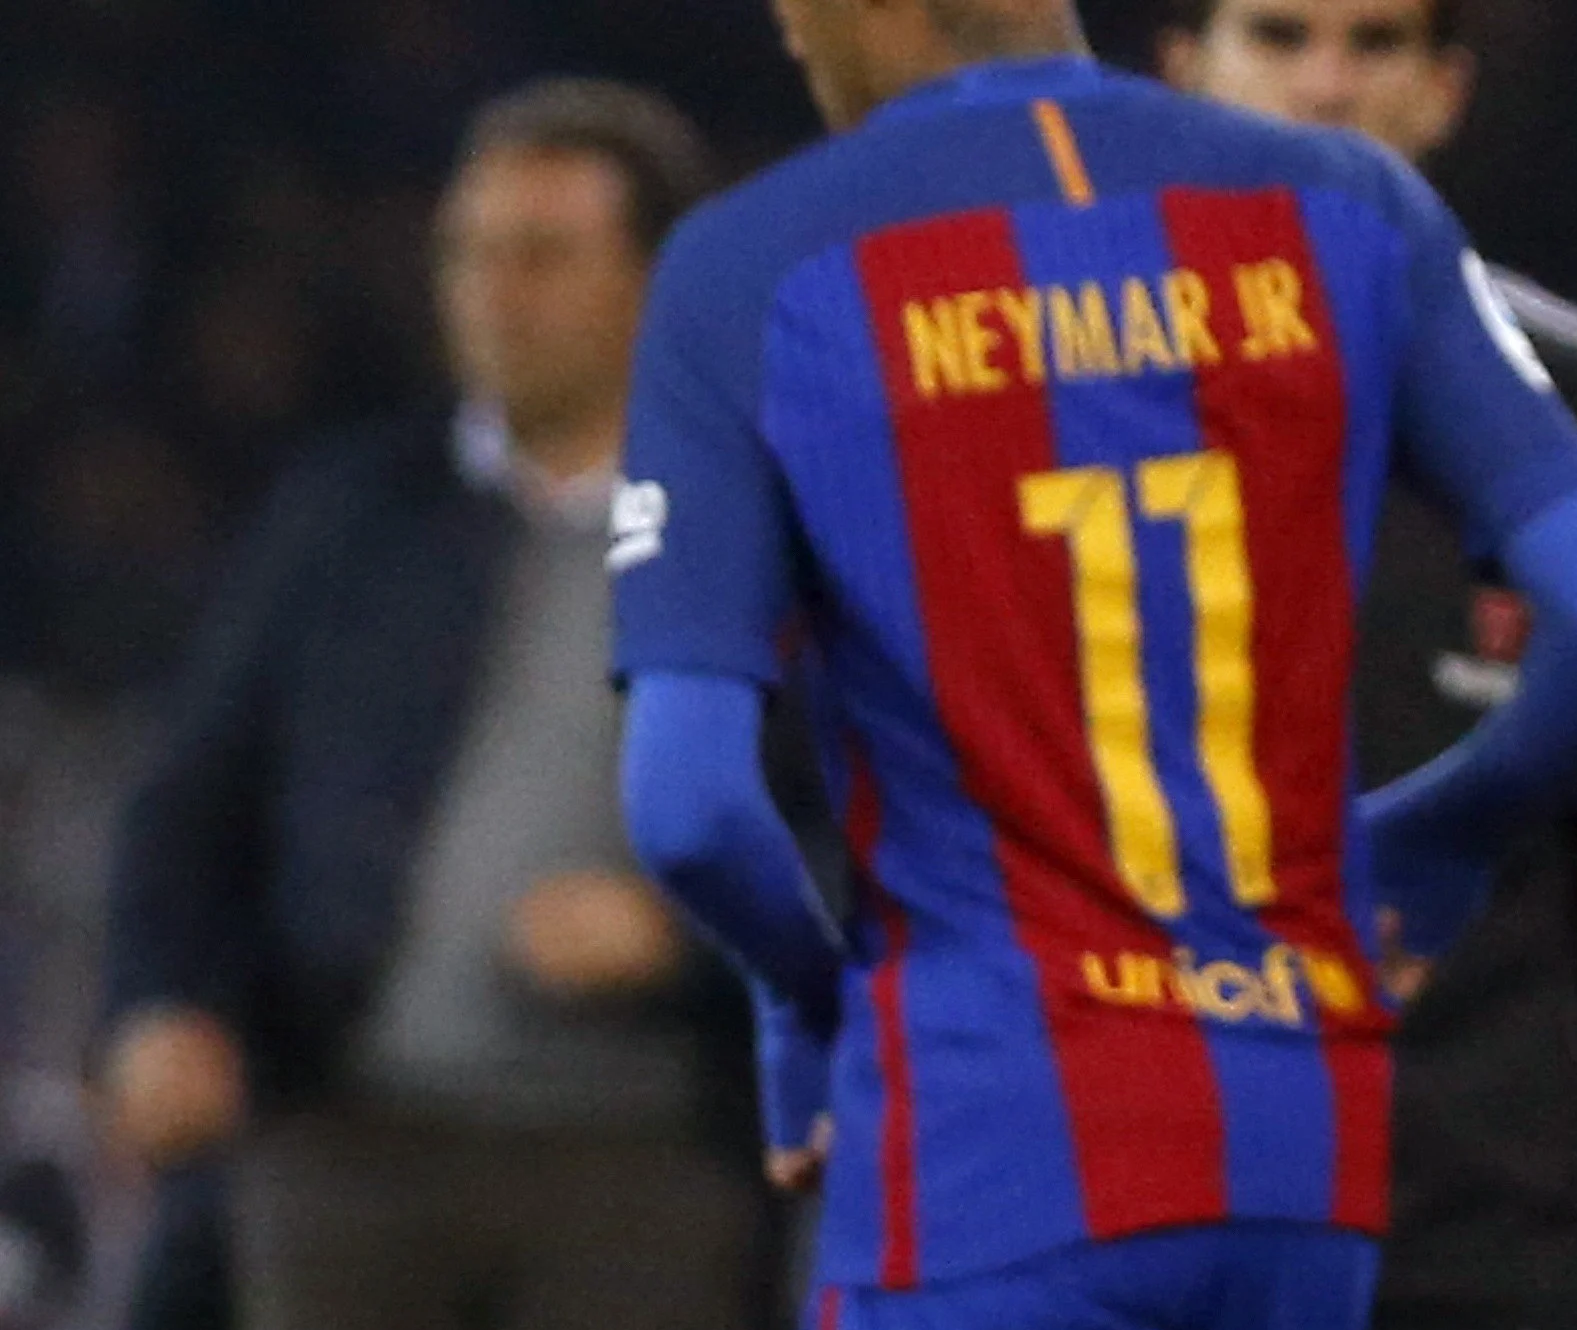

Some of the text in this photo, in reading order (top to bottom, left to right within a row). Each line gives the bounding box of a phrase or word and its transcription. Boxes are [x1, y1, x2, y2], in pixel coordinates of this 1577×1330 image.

[904, 258, 1317, 397] NEYMAR JR
[1018, 451, 1277, 916] 11
[1081, 944, 1300, 1027] unicf
